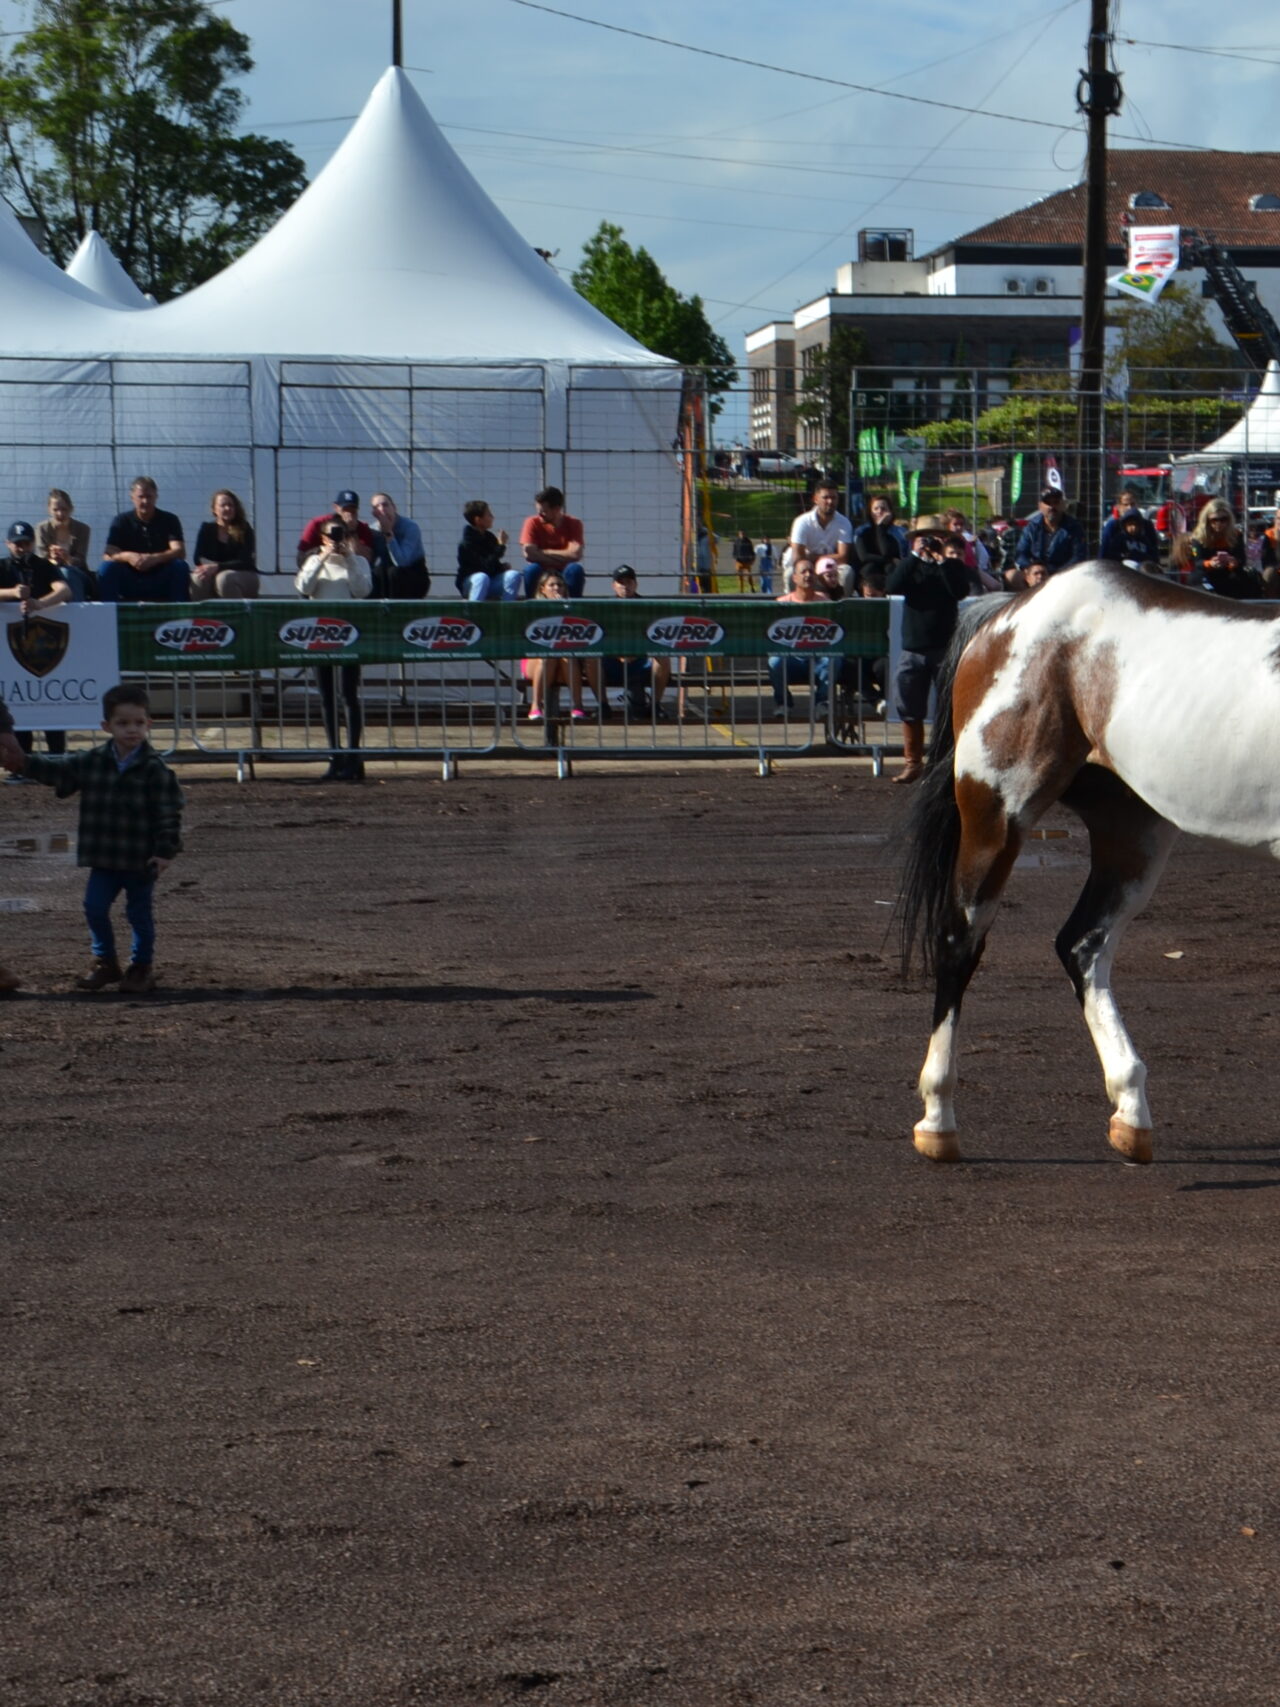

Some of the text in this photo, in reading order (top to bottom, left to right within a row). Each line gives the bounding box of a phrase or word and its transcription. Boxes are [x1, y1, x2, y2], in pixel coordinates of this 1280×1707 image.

[160, 625, 229, 643] SUPRA
[284, 625, 354, 642] SUPRA
[408, 624, 476, 641] SUPRA
[530, 624, 598, 641] SUPRA
[651, 623, 718, 641] SUPRA
[771, 623, 840, 641] SUPRA
[0, 679, 97, 702] AUCCC
